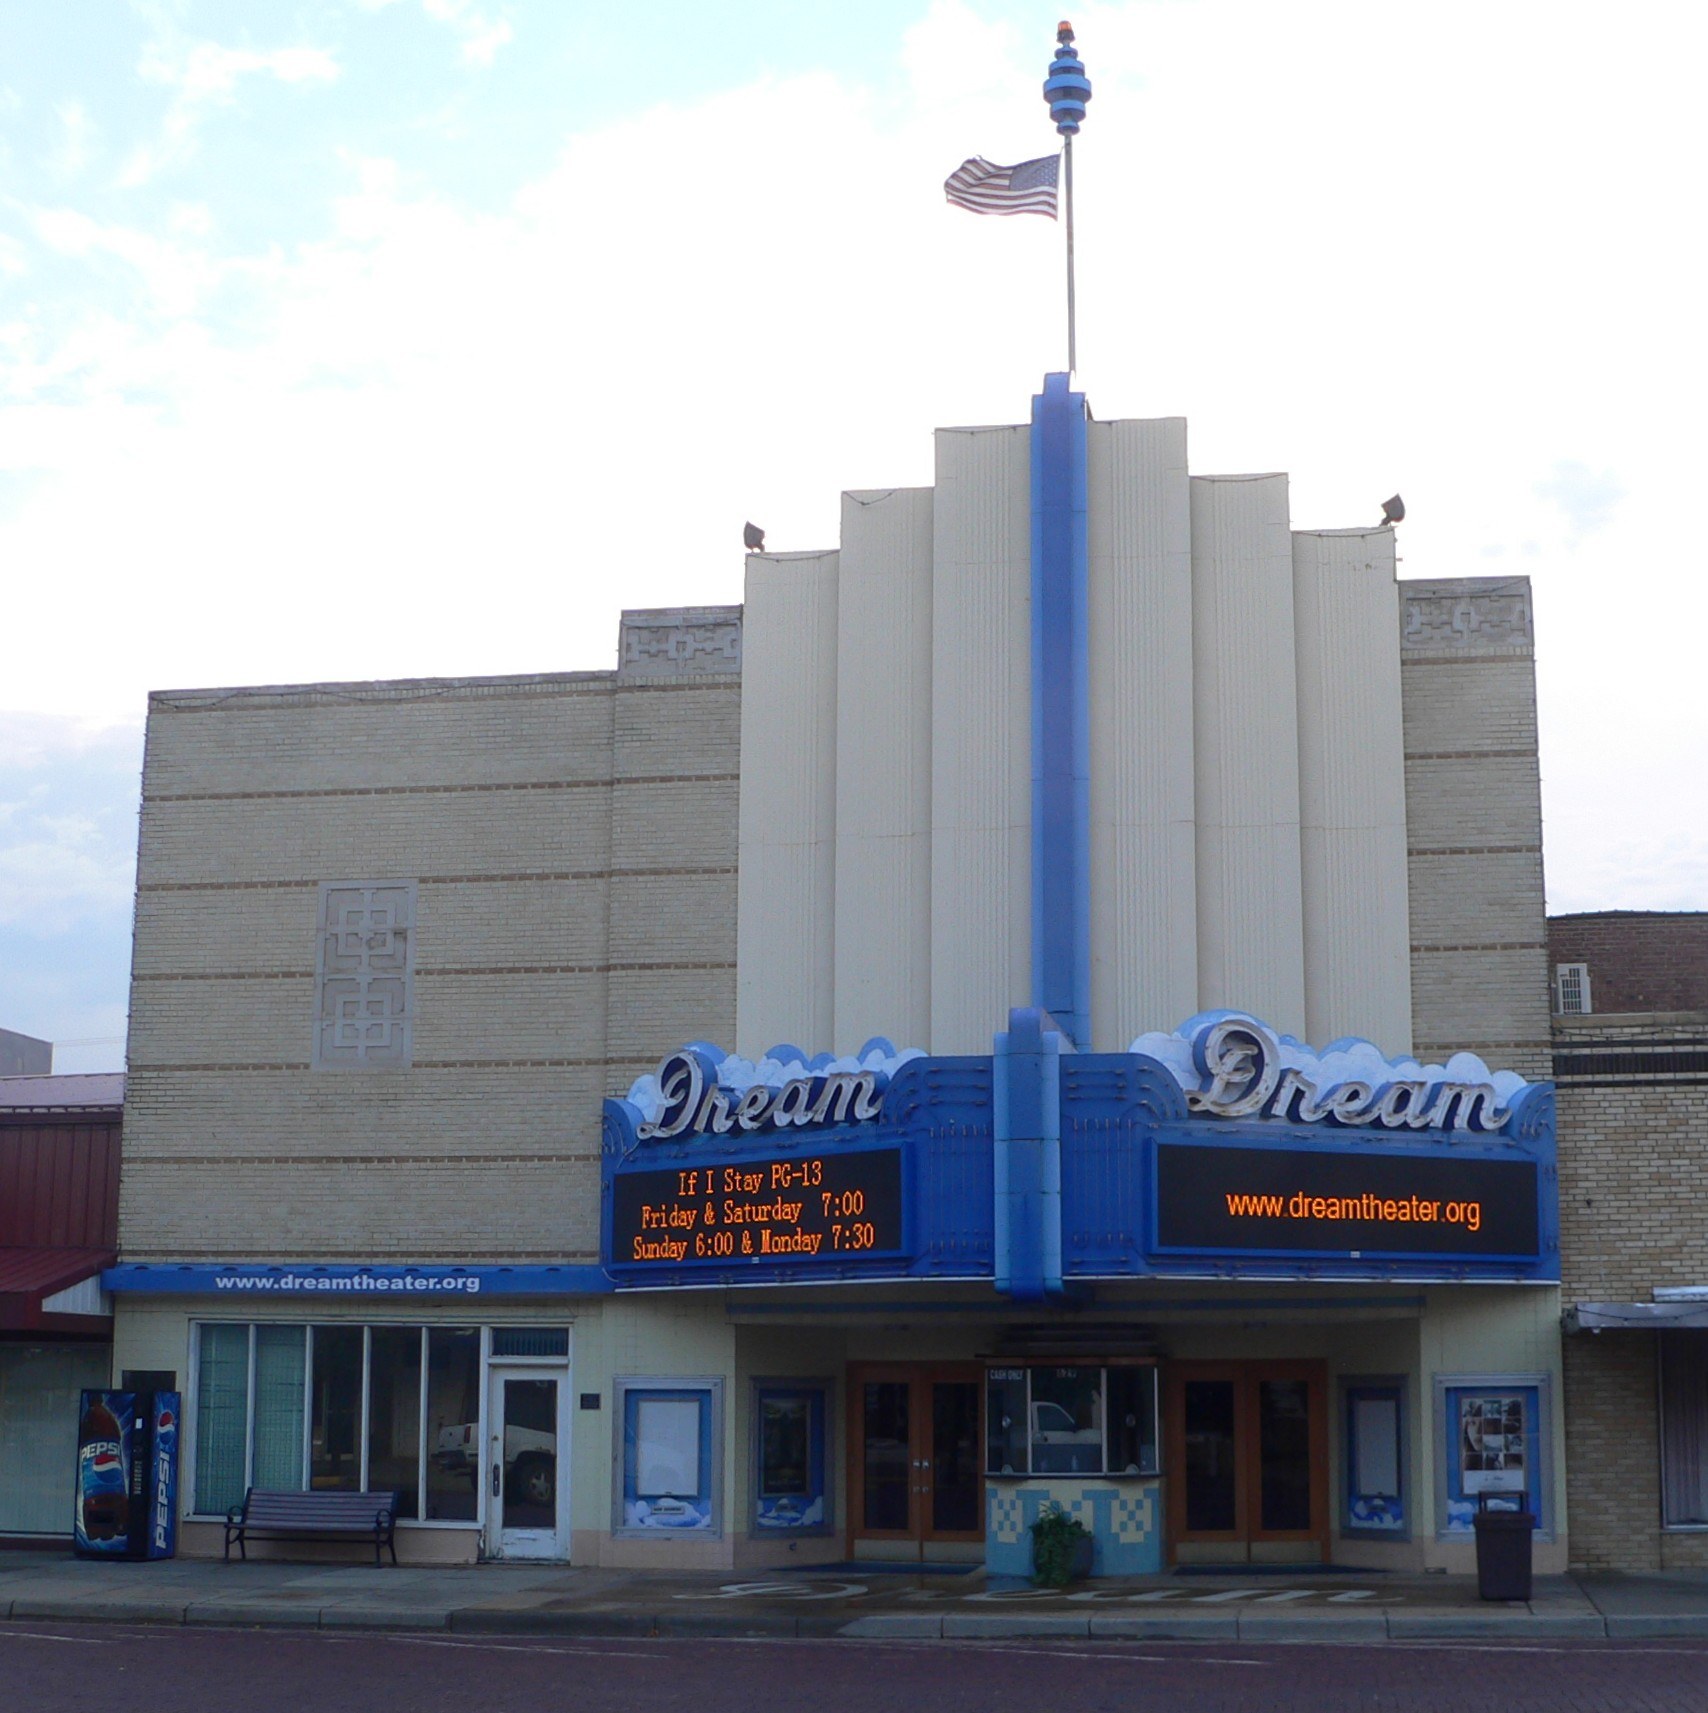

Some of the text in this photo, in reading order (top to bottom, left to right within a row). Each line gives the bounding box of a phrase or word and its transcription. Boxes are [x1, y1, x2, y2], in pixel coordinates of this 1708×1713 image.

[636, 1050, 884, 1140] Dream
[1186, 1019, 1512, 1131] Dream
[678, 1160, 823, 1196] If I Stay PG-13
[641, 1190, 864, 1230] Friday & Saturday 7:00
[1225, 1191, 1480, 1232] www.dreamtheater.org
[633, 1223, 875, 1262] Sunday 6:00 & Monday 7:30
[215, 1273, 481, 1293] www.dreamtheater.org
[81, 1441, 121, 1460] PEPSI
[156, 1449, 171, 1549] PEPSI
